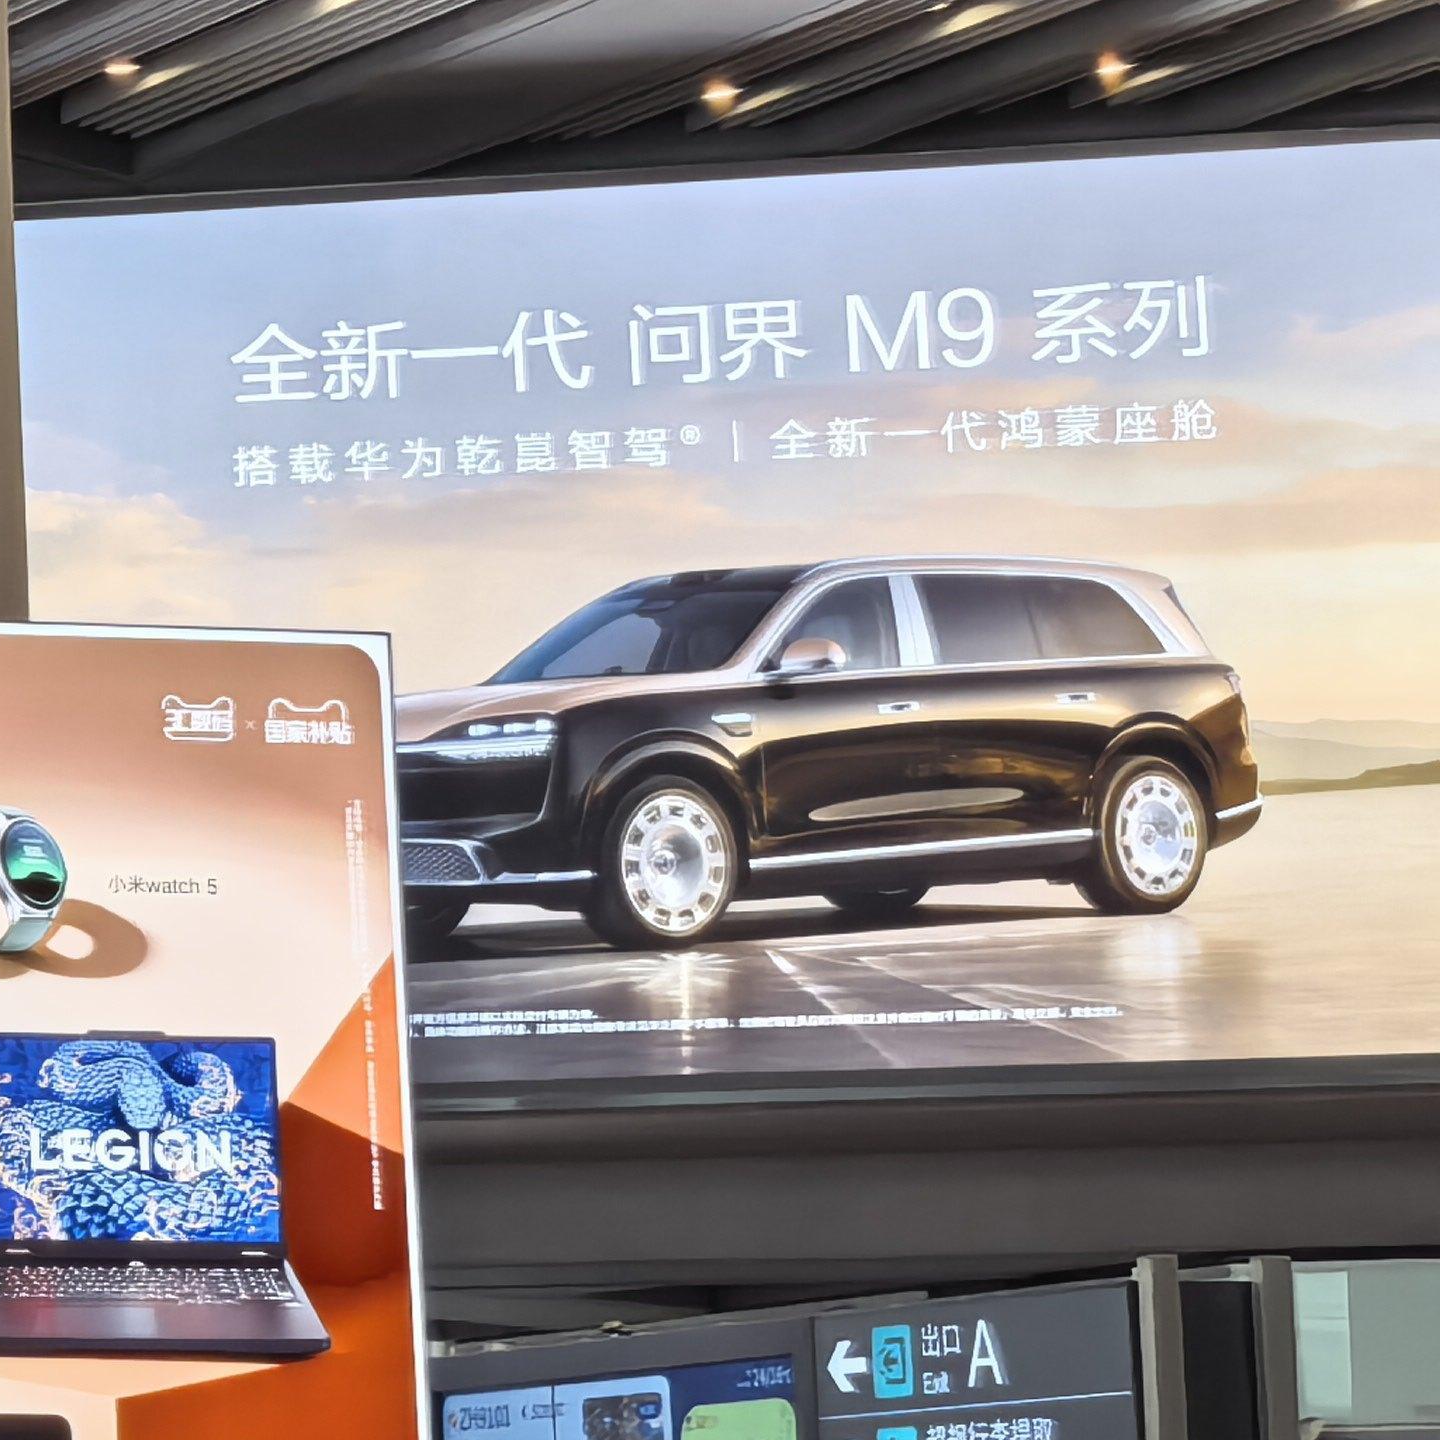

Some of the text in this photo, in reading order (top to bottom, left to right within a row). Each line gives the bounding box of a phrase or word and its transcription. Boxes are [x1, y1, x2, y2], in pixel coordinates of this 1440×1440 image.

[230, 274, 1212, 404] 全新一代 问界 M9 系列
[769, 397, 1219, 461] 全新一代鸿蒙座舱
[264, 718, 353, 745] 国家补贴
[207, 878, 218, 895] 5
[30, 1127, 233, 1174] LEGION
[921, 1318, 1005, 1388] 出口 A
